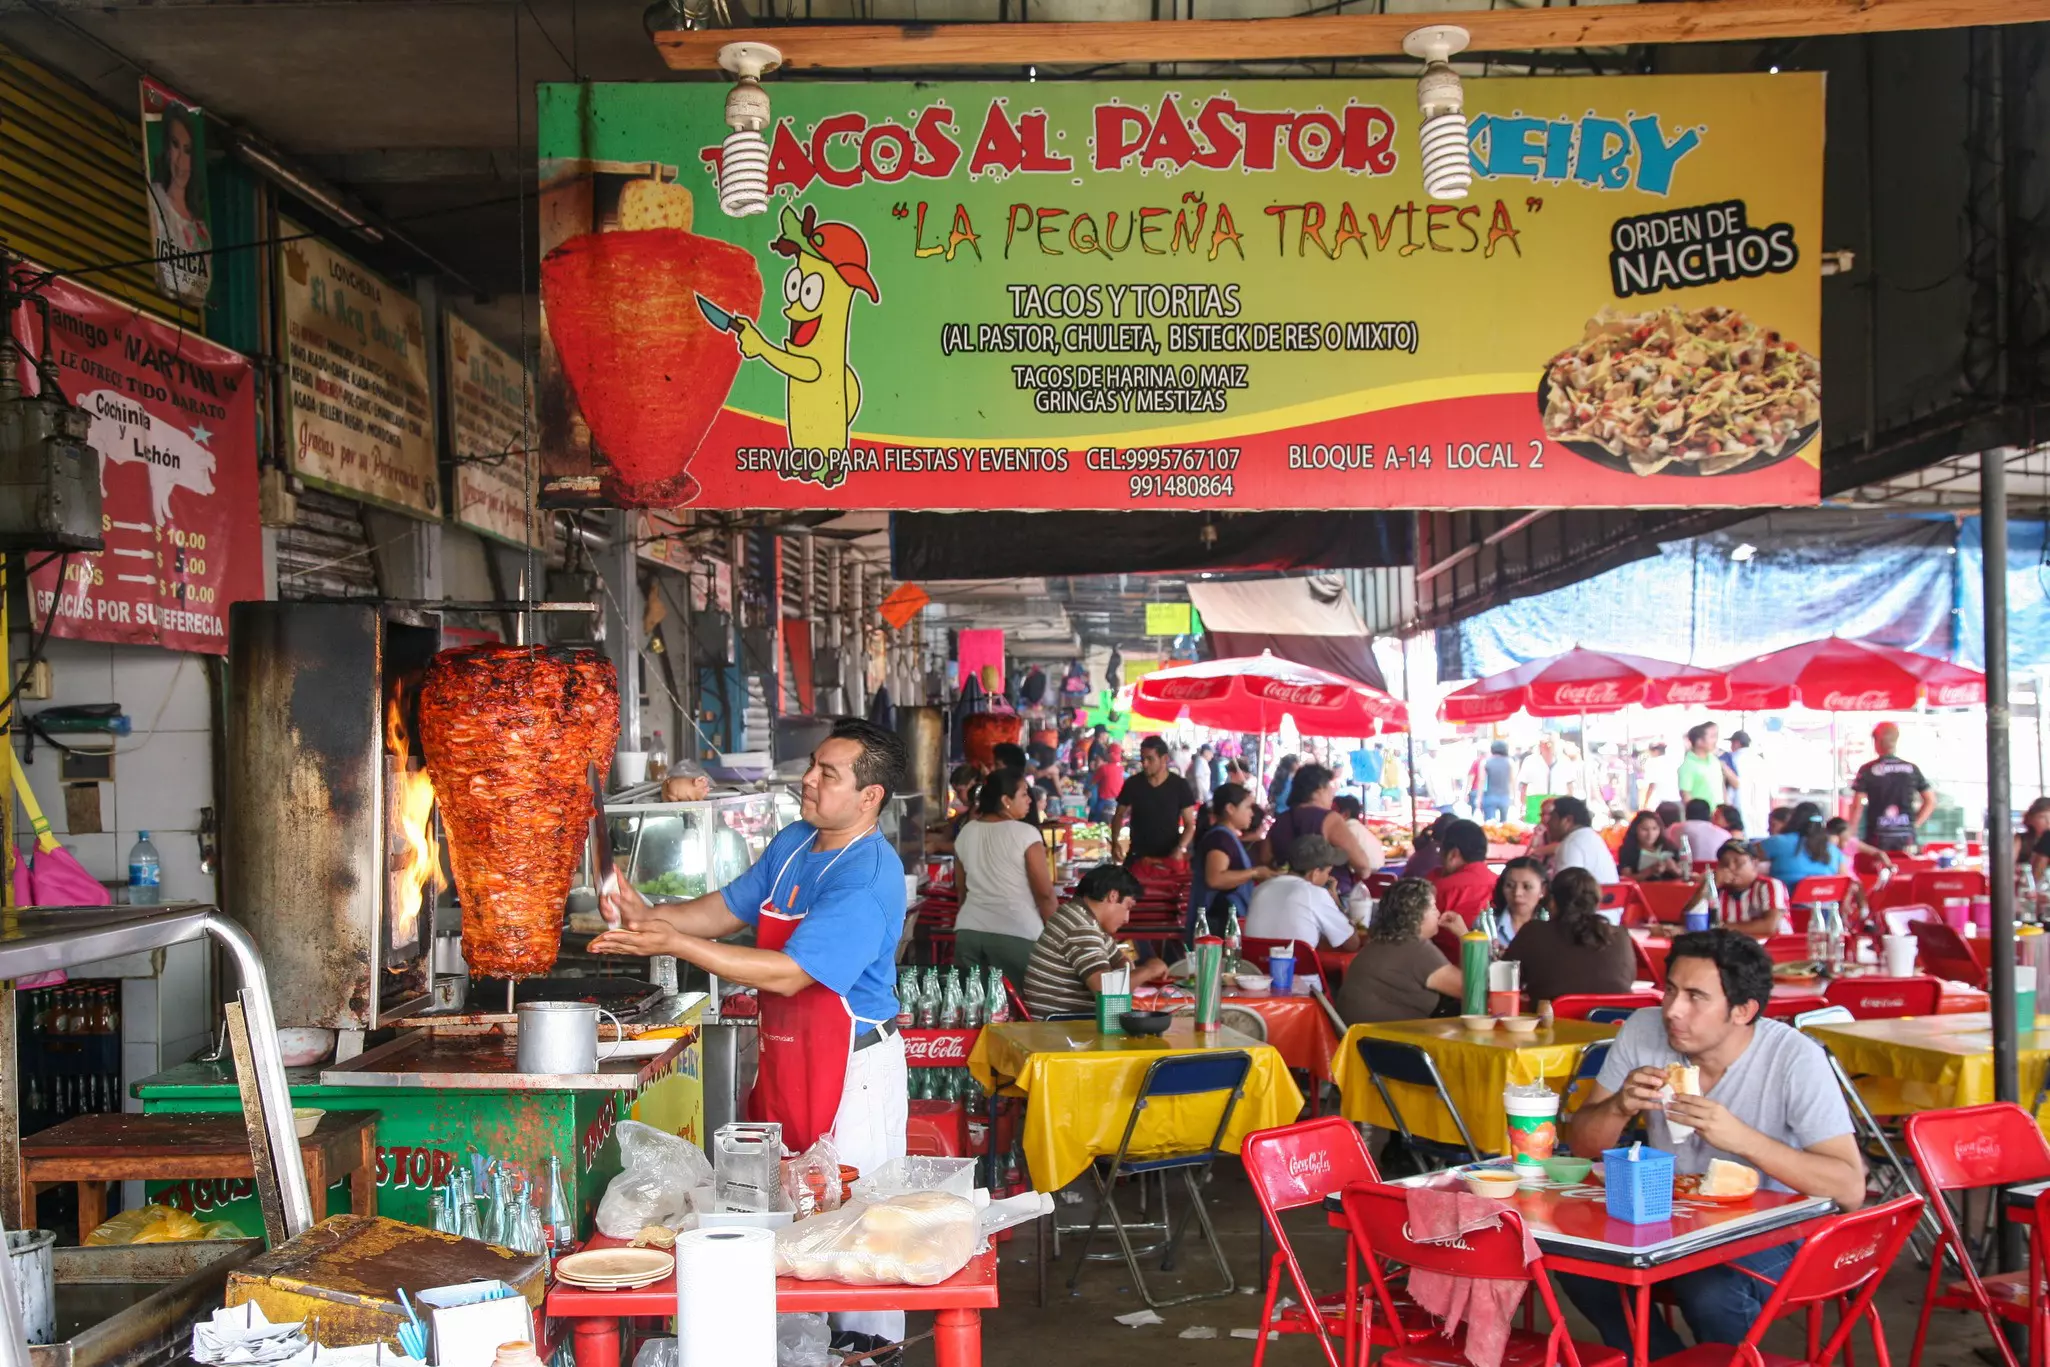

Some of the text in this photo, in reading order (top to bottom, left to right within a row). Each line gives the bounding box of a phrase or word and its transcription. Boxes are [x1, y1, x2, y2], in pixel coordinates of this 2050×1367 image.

[970, 98, 1073, 177] AL
[1094, 93, 1398, 177] PASTOR
[1004, 191, 1245, 262] PEQUEÑA
[1615, 205, 1743, 253] ORDEN DE
[1616, 236, 1797, 293] NACHOS
[1008, 284, 1241, 319] TACOS Y TORTAS
[52, 308, 108, 349] amigo
[941, 322, 1420, 356] (AL PASTOR, CHULETA, BISTECK DE RES O MIXTO)
[60, 349, 78, 370] LE
[81, 358, 123, 389] OFRECE
[171, 391, 226, 420] BARATO
[1013, 364, 1248, 389] TACOS DE HARINA O MAIZ
[96, 393, 151, 431] Cochinia
[1035, 389, 1227, 413] GRINGAS Y MESTIZAS
[736, 440, 1544, 474] SERVICIO PARA FIESTAS Y EVENTOS CEL:9995767107 BLOQUE A-14 LOCAL 2
[1128, 474, 1234, 498] 991480864
[167, 528, 206, 550] 10.00
[37, 590, 93, 620] GRACIAS
[98, 599, 131, 624] POR
[170, 582, 214, 604] 10.00
[376, 1146, 455, 1190] STOR
